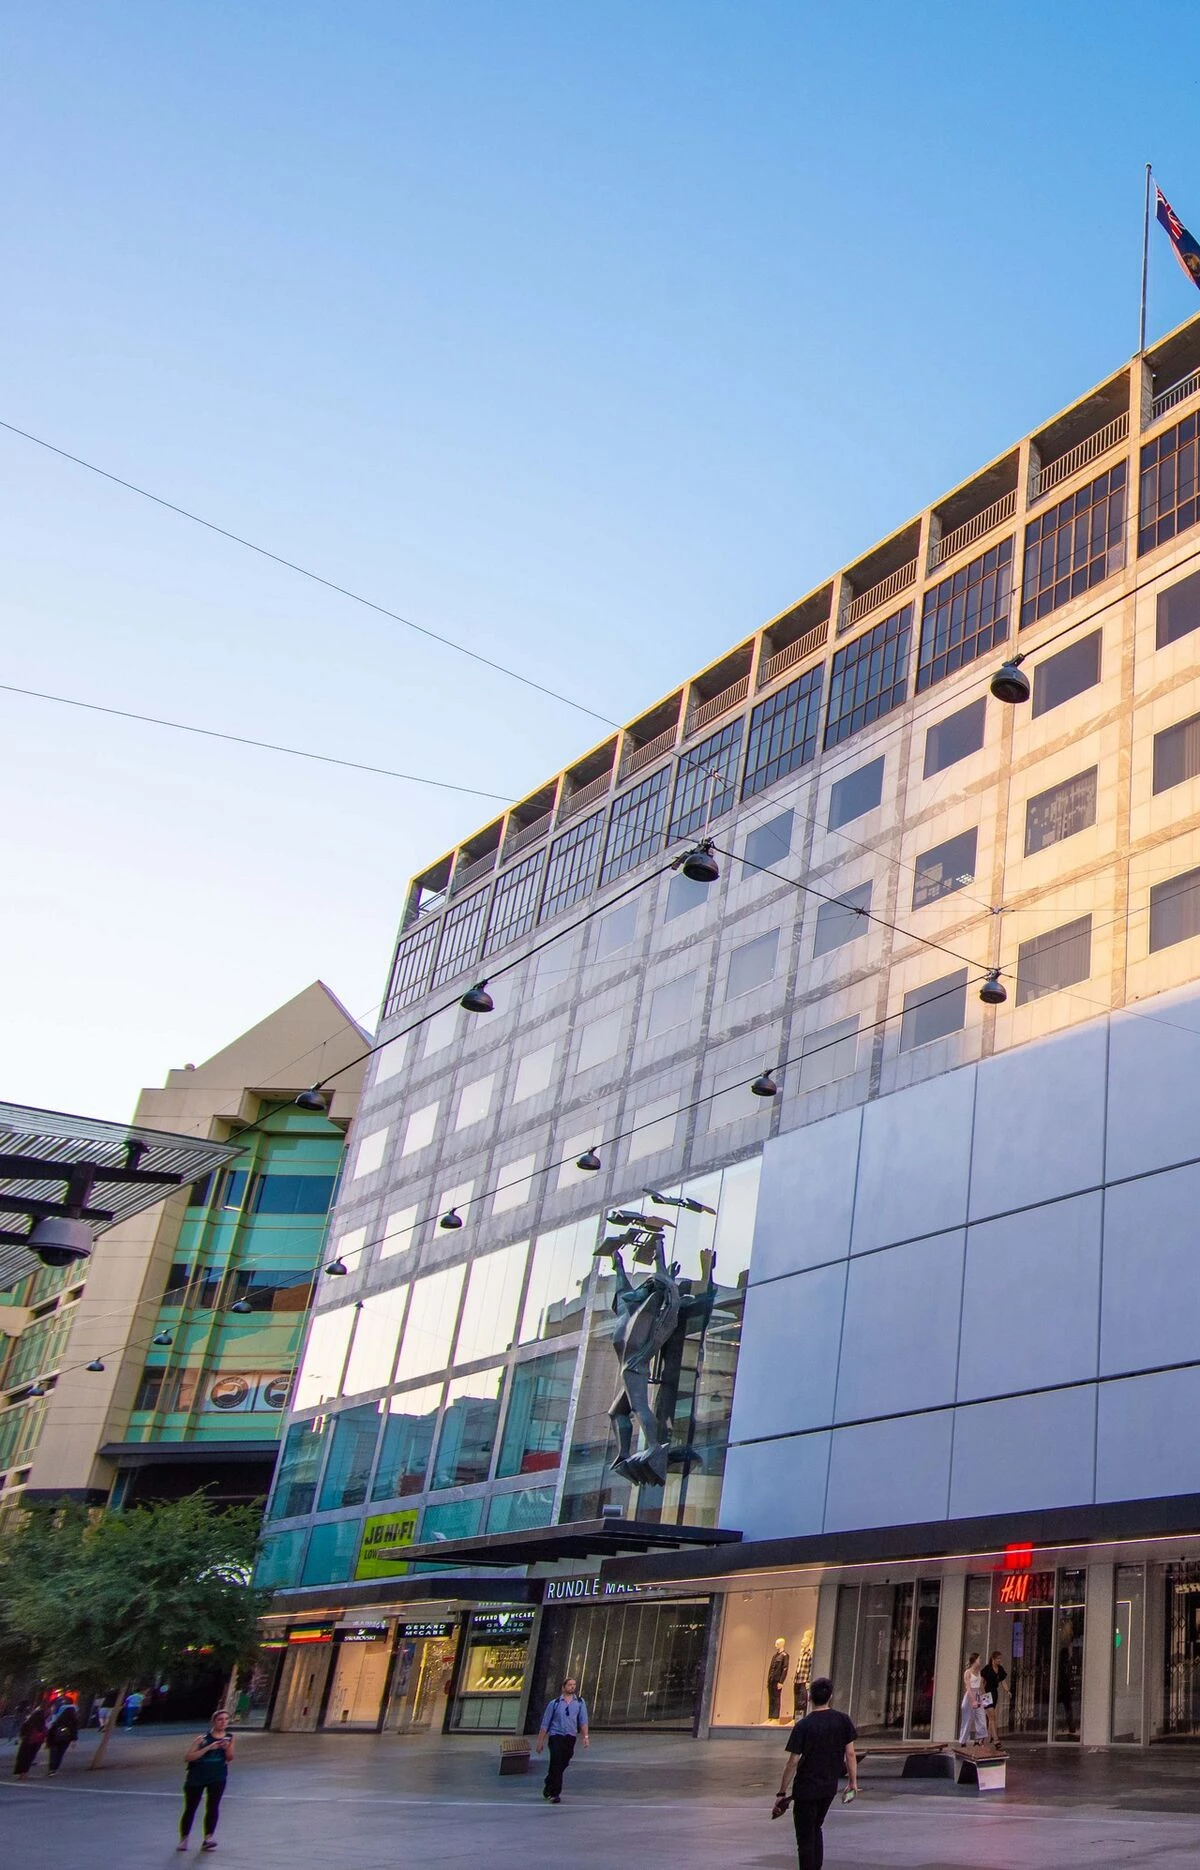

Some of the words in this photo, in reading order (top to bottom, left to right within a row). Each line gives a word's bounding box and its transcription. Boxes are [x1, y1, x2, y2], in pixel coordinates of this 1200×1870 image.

[364, 1526, 384, 1545] JB
[547, 1578, 600, 1599] RUNDLE
[1000, 1574, 1029, 1604] H&M
[474, 1614, 498, 1622] GERARD
[344, 1634, 377, 1642] SWAROVSKI
